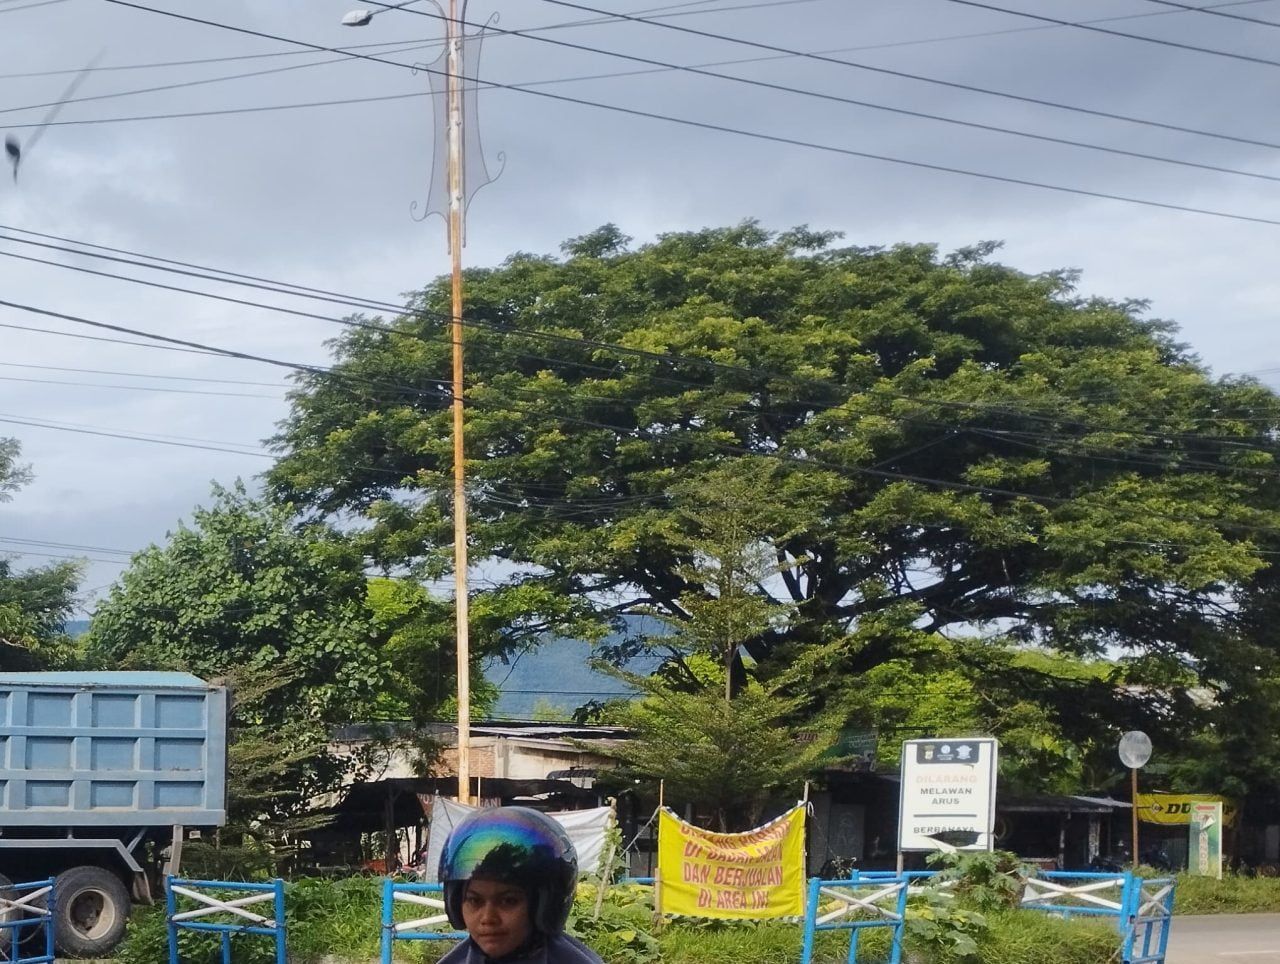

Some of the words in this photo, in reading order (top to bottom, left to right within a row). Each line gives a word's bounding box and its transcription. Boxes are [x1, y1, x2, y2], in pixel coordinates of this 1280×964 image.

[916, 774, 977, 784] DILARANG
[920, 787, 972, 795] MELAWAN
[931, 797, 960, 805] ARUS
[683, 862, 711, 884] DAN
[713, 865, 783, 888] BERJUALAN
[698, 887, 712, 908] DI
[716, 889, 747, 909] AREA
